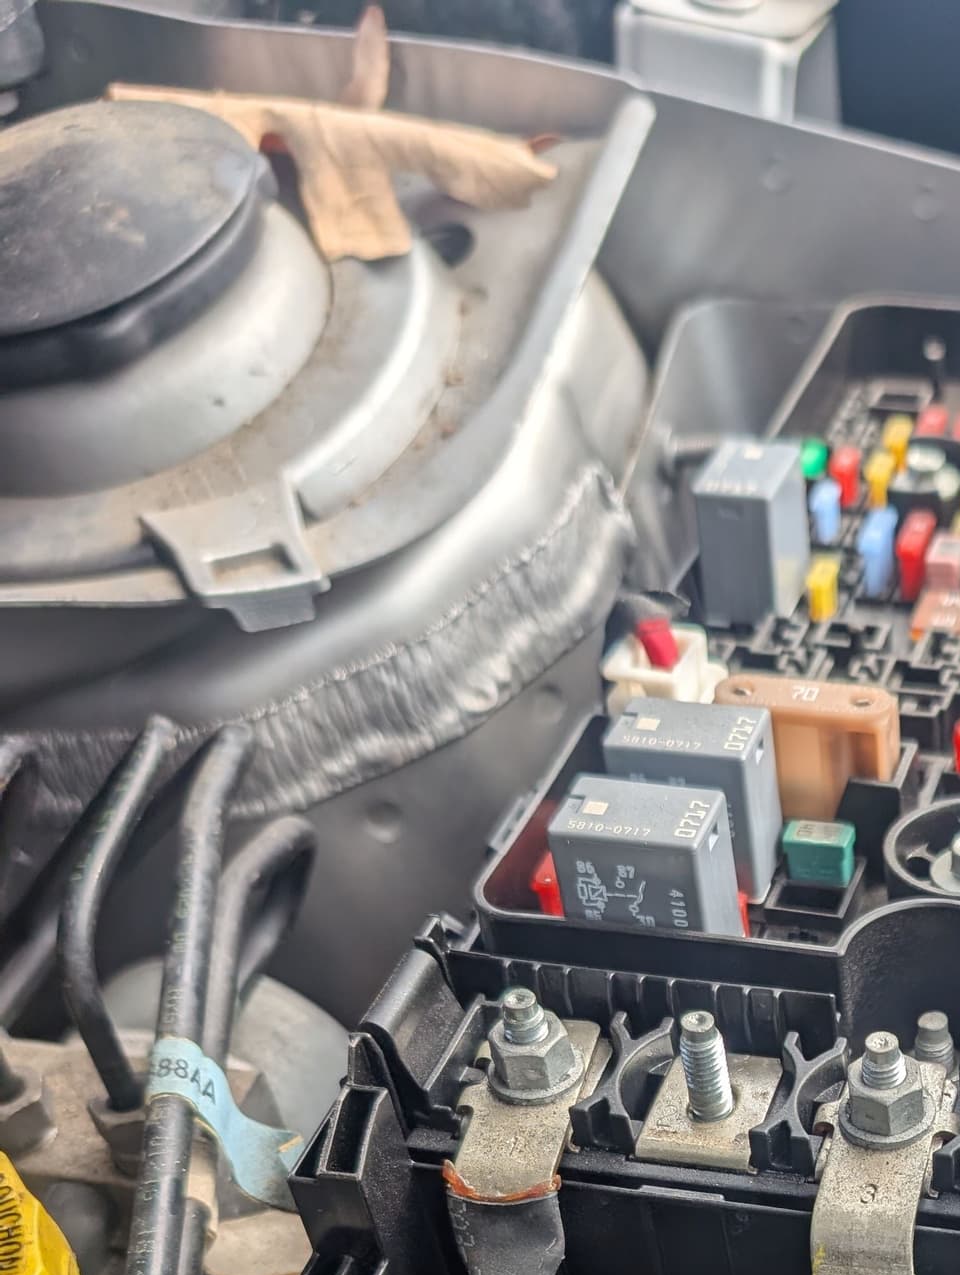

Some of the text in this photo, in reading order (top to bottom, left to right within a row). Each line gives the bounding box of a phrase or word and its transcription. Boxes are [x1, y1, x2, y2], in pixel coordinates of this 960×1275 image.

[792, 686, 820, 701] 70
[622, 735, 702, 750] 5810-0717
[723, 716, 757, 751] 0717
[567, 820, 651, 837] 5810-0717
[673, 800, 710, 839] 0717
[860, 1183, 878, 1204] 3
[0, 1173, 24, 1275] OUCHON
